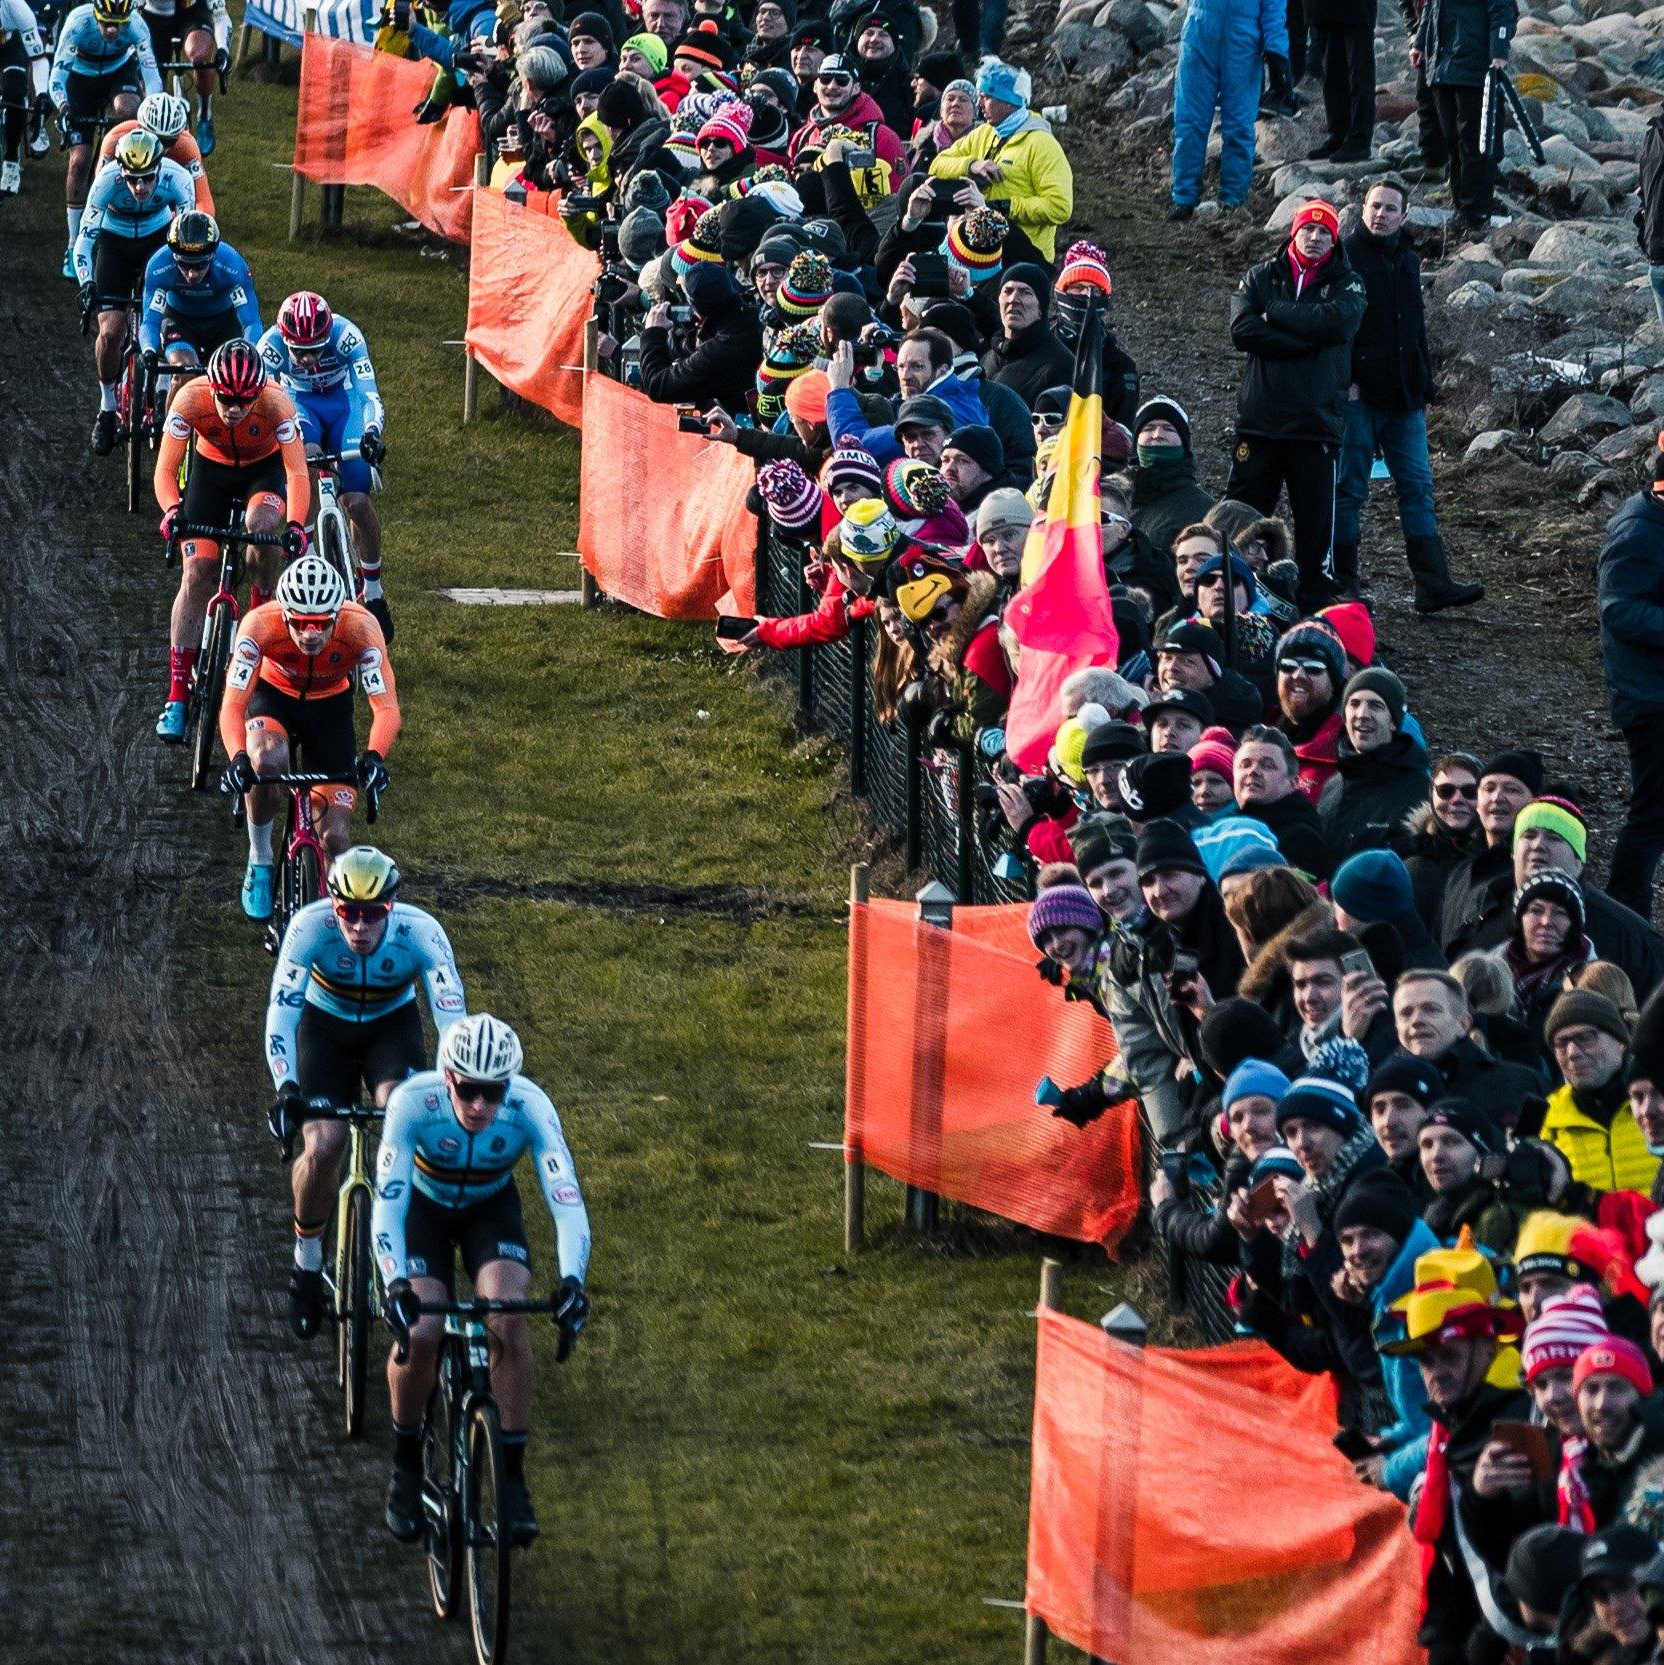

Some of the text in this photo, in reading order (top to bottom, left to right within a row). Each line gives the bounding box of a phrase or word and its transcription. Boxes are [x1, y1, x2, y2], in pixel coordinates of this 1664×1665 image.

[89, 210, 99, 220] 7
[356, 363, 370, 375] 28
[363, 672, 380, 688] 14
